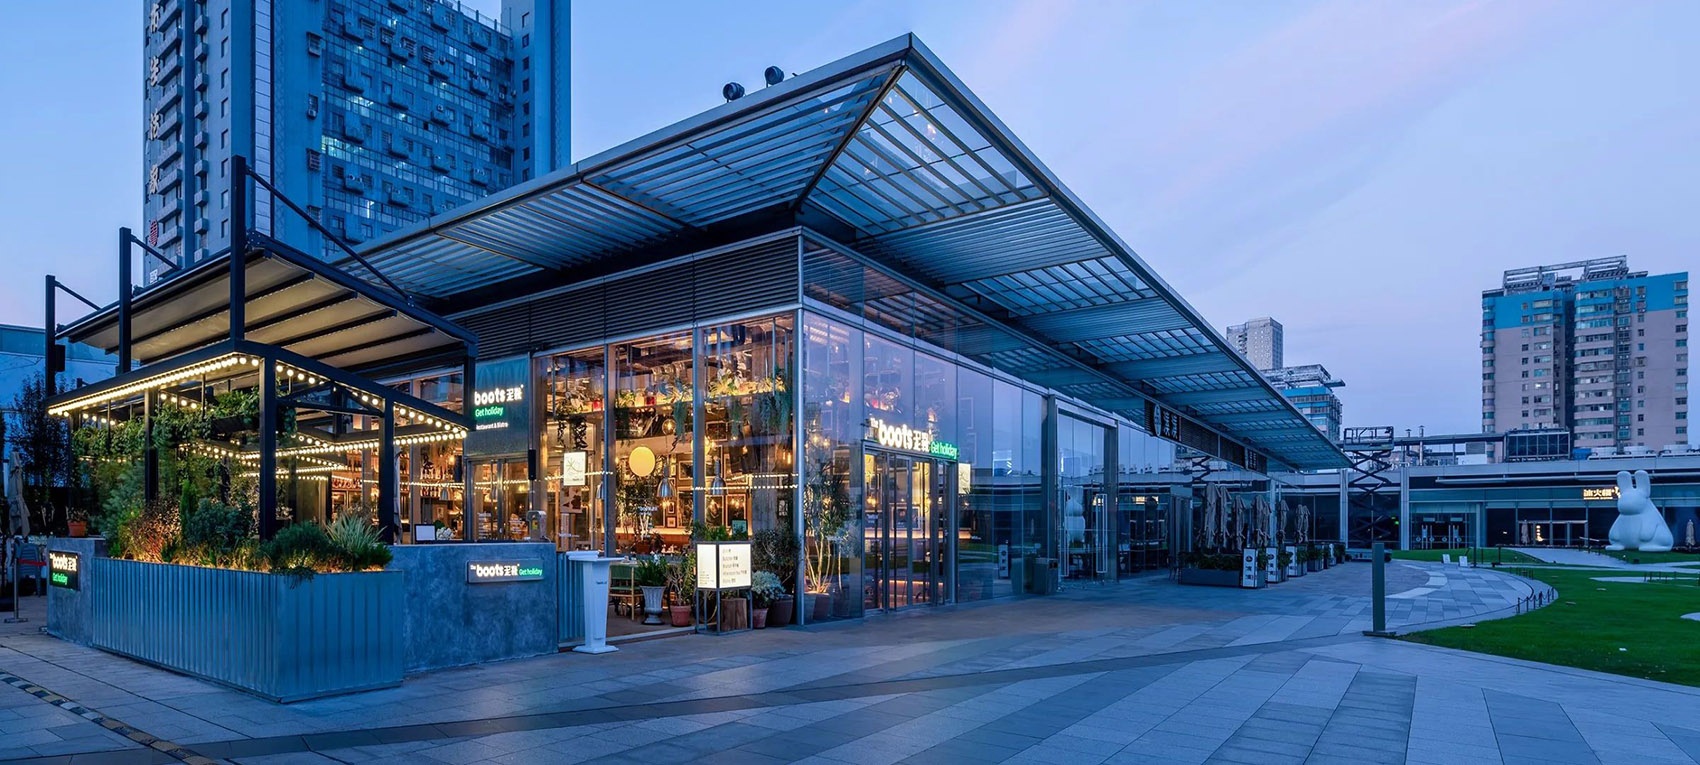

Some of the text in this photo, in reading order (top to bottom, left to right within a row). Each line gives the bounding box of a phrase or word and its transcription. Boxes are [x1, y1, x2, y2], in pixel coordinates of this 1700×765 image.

[474, 388, 505, 405] boots
[475, 406, 503, 417] Get holiday
[879, 419, 913, 449] boots
[940, 442, 957, 459] holiday
[476, 564, 504, 577] boots
